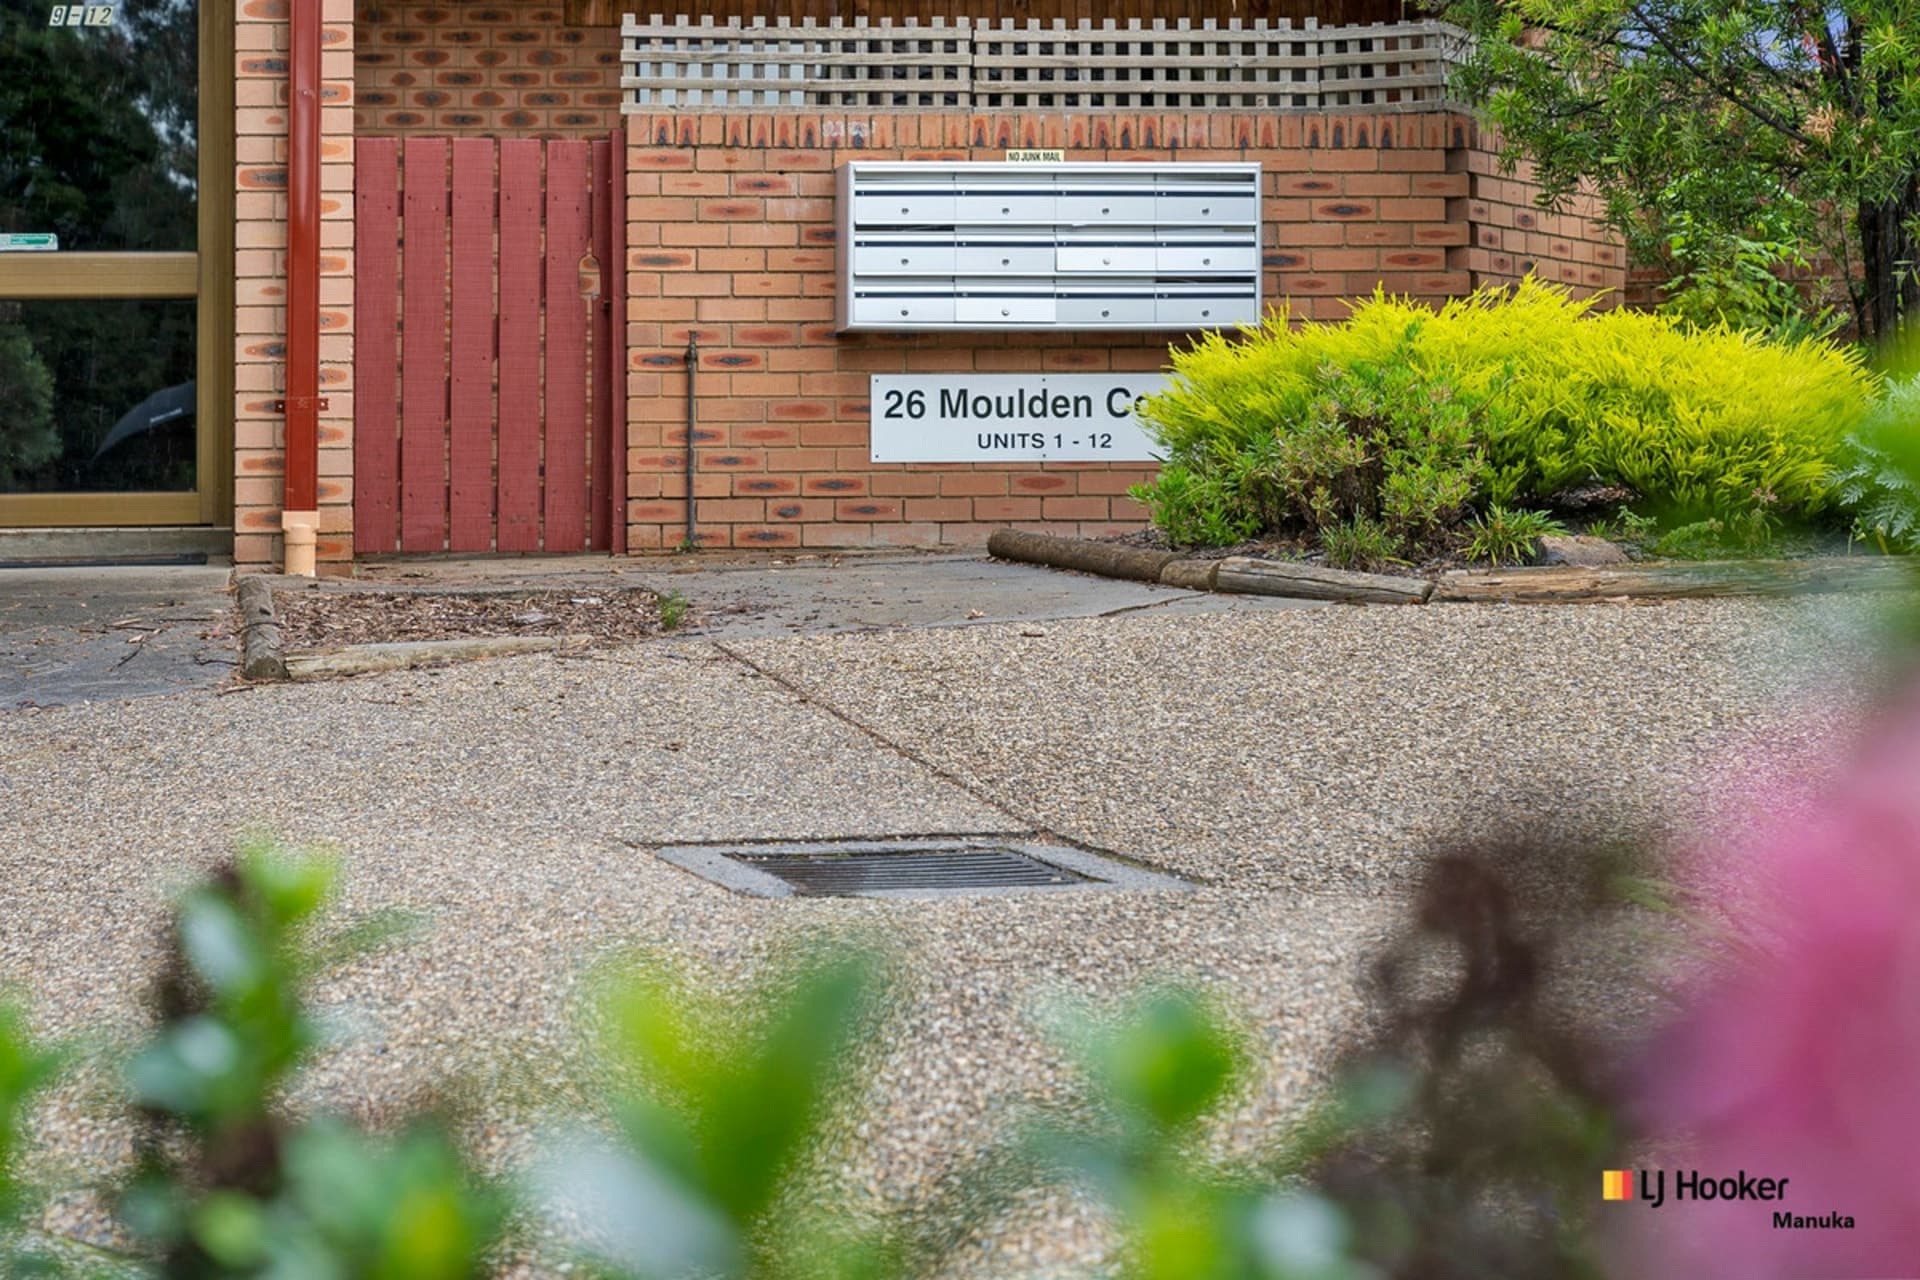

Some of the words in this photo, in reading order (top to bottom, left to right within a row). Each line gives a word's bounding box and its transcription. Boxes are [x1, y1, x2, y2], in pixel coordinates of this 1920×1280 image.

[52, 7, 112, 24] 9-12
[1008, 151, 1020, 161] NO
[1021, 151, 1041, 162] JUNK
[1043, 151, 1061, 162] MAIL
[884, 389, 926, 419] 26
[940, 388, 1092, 418] Moulden
[977, 433, 1045, 449] UNITS
[1054, 434, 1062, 448] 1
[1088, 433, 1112, 449] 12
